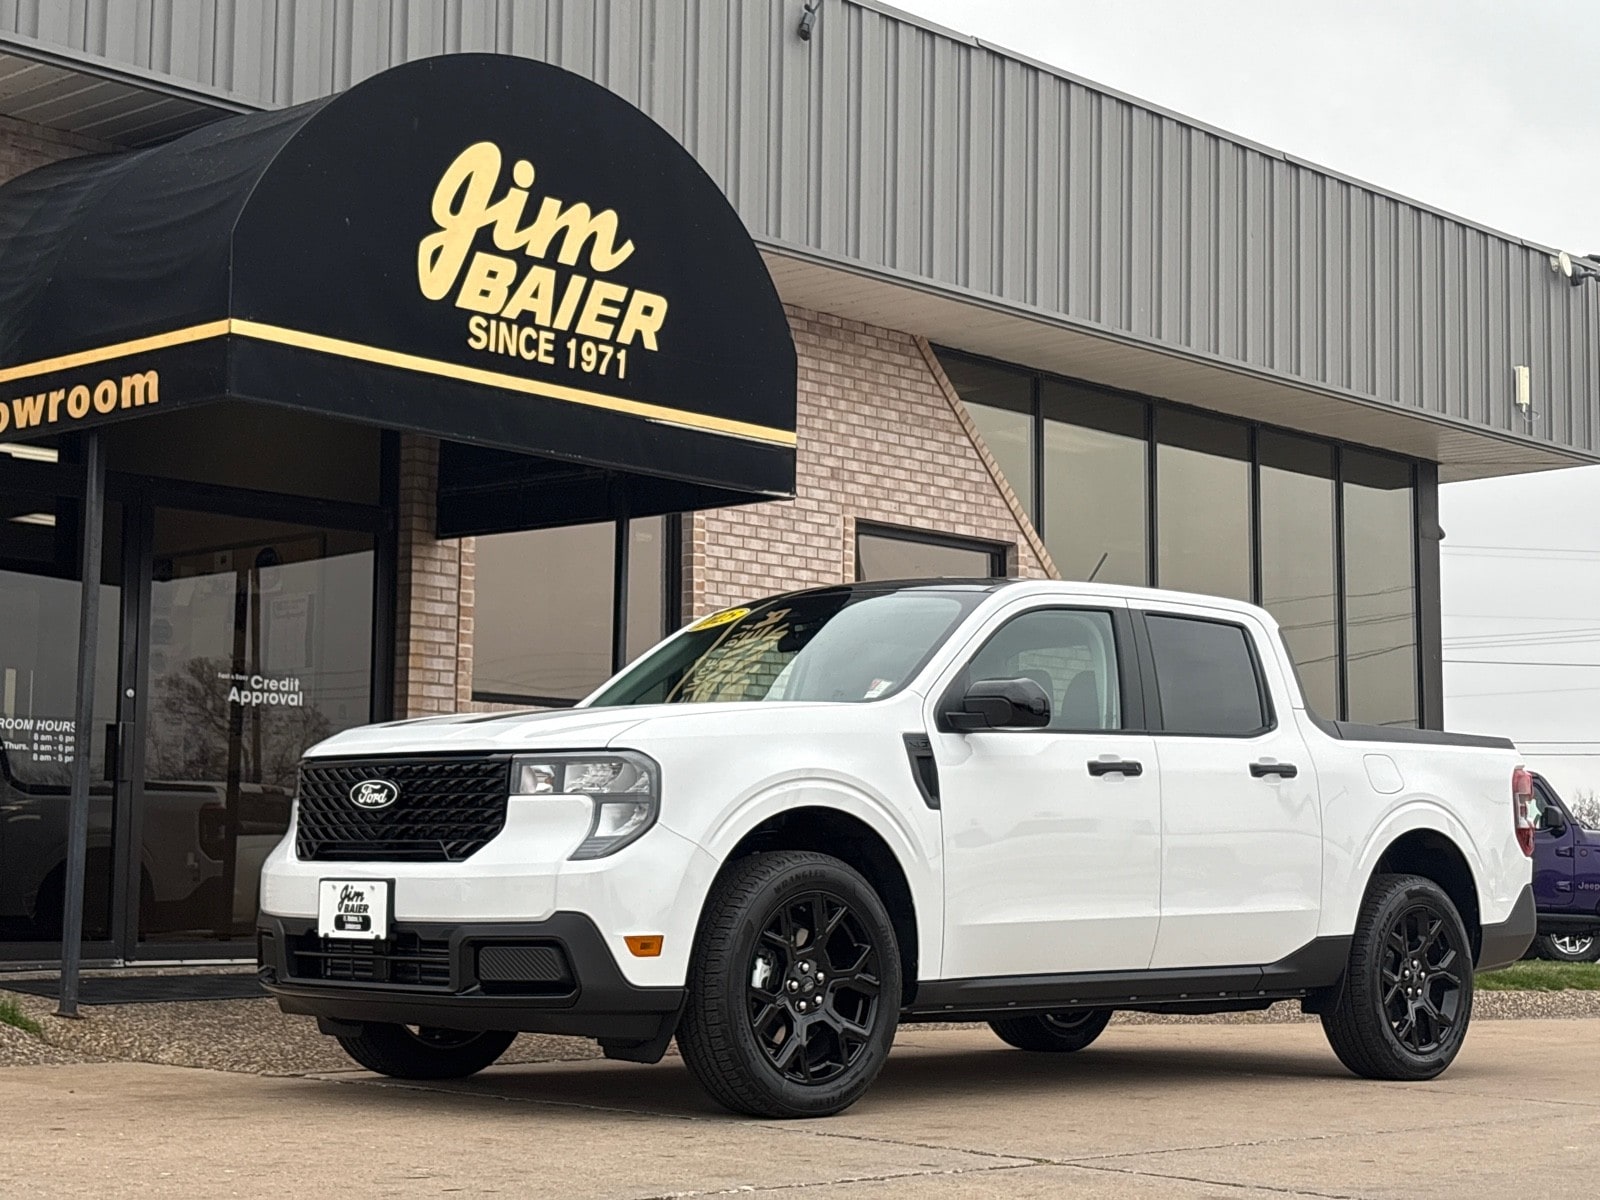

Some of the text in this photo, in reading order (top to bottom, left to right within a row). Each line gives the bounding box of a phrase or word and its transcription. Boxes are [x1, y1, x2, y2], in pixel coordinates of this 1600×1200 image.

[418, 141, 636, 301] Jim
[454, 251, 669, 352] BAIER
[467, 315, 627, 379] SINCE 1971
[250, 675, 300, 692] Credit
[228, 686, 303, 706] Approval
[36, 720, 75, 732] HOURS
[358, 783, 389, 804] Ford
[1577, 881, 1600, 891] Jeep
[338, 884, 364, 912] Jim
[344, 903, 369, 913] BAIER
